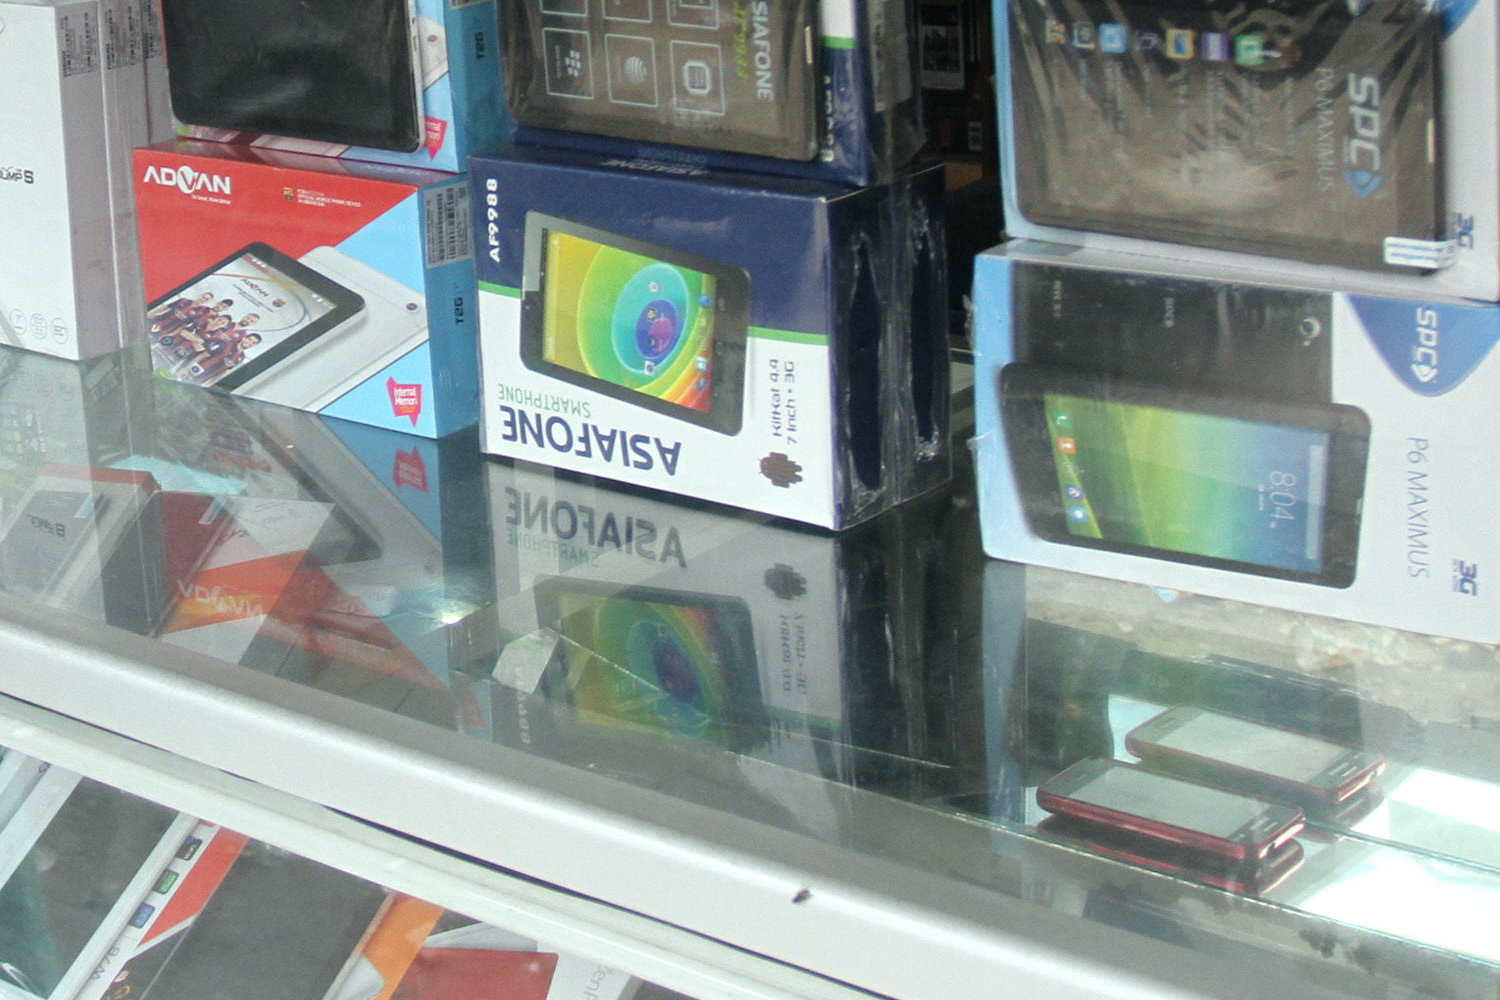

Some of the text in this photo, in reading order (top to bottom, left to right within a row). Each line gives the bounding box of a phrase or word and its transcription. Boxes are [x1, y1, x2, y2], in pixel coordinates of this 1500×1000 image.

[1317, 98, 1336, 192] MAXIMUS
[1348, 73, 1381, 172] SPC
[143, 165, 231, 195] ADVAN
[486, 178, 502, 263] AF9988
[241, 278, 269, 297] ADVAN
[1413, 307, 1439, 367] SPC
[498, 383, 591, 418] SMARTPHONE
[501, 405, 681, 475] ASIAFONE
[1406, 437, 1429, 579] P6 MAXIMUS
[1459, 560, 1478, 596] 3G
